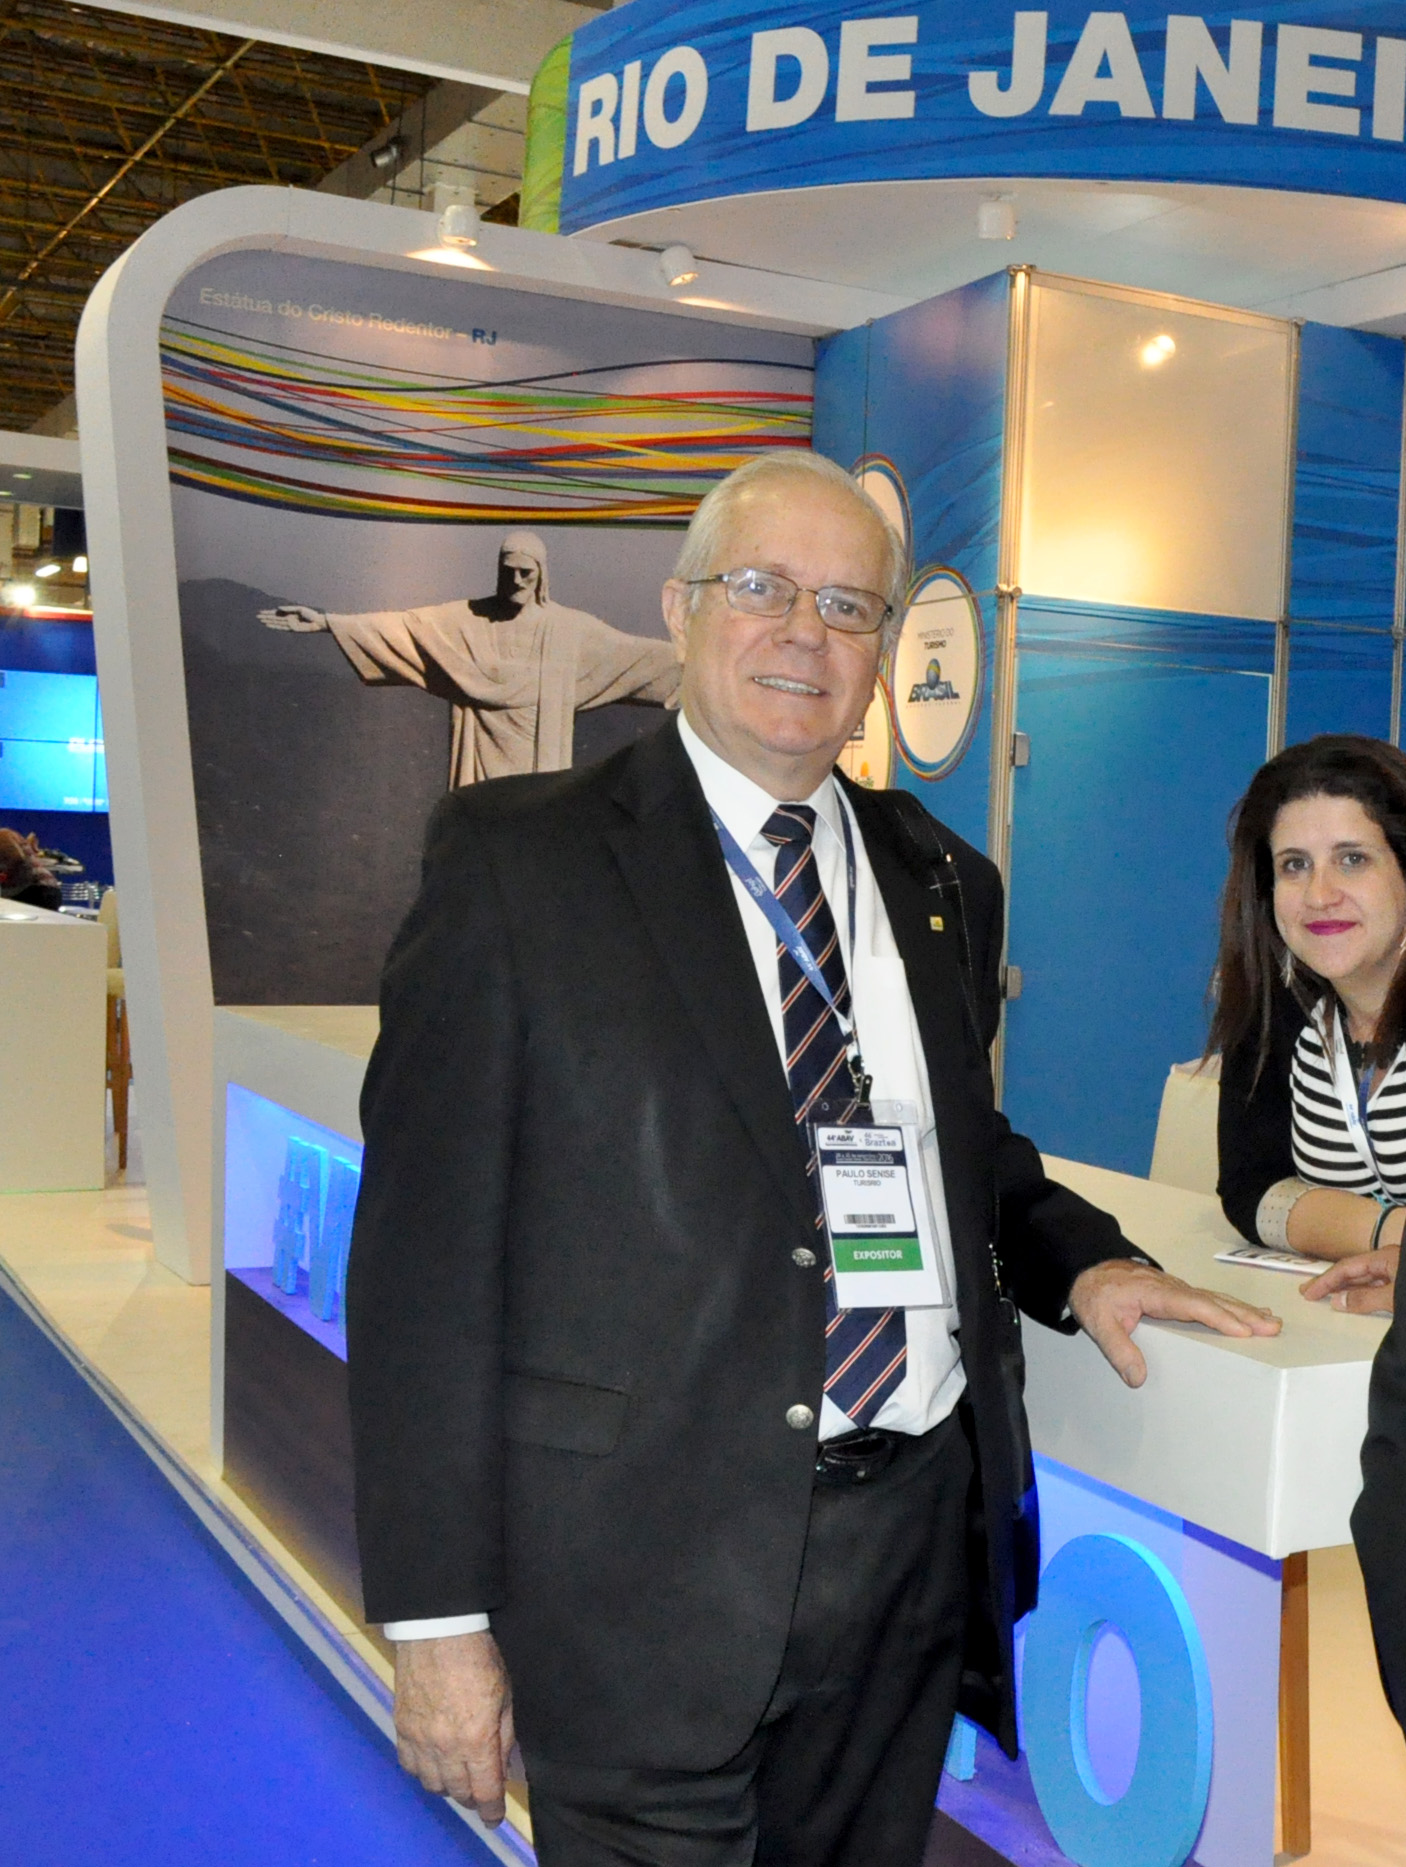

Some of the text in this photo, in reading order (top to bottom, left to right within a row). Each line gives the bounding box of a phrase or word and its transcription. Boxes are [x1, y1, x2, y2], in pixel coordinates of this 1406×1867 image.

[572, 45, 709, 178] RIO
[745, 15, 919, 132] DE
[200, 287, 273, 315] Estátua
[277, 299, 301, 318] do
[307, 303, 364, 327] Cristo
[368, 312, 453, 340] Redentor
[471, 328, 497, 345] RJ
[923, 639, 947, 650] TURISMO
[907, 681, 960, 703] BRASIL
[836, 1170, 896, 1178] PAULO SENISE
[853, 1249, 904, 1260] EXPOSITOR
